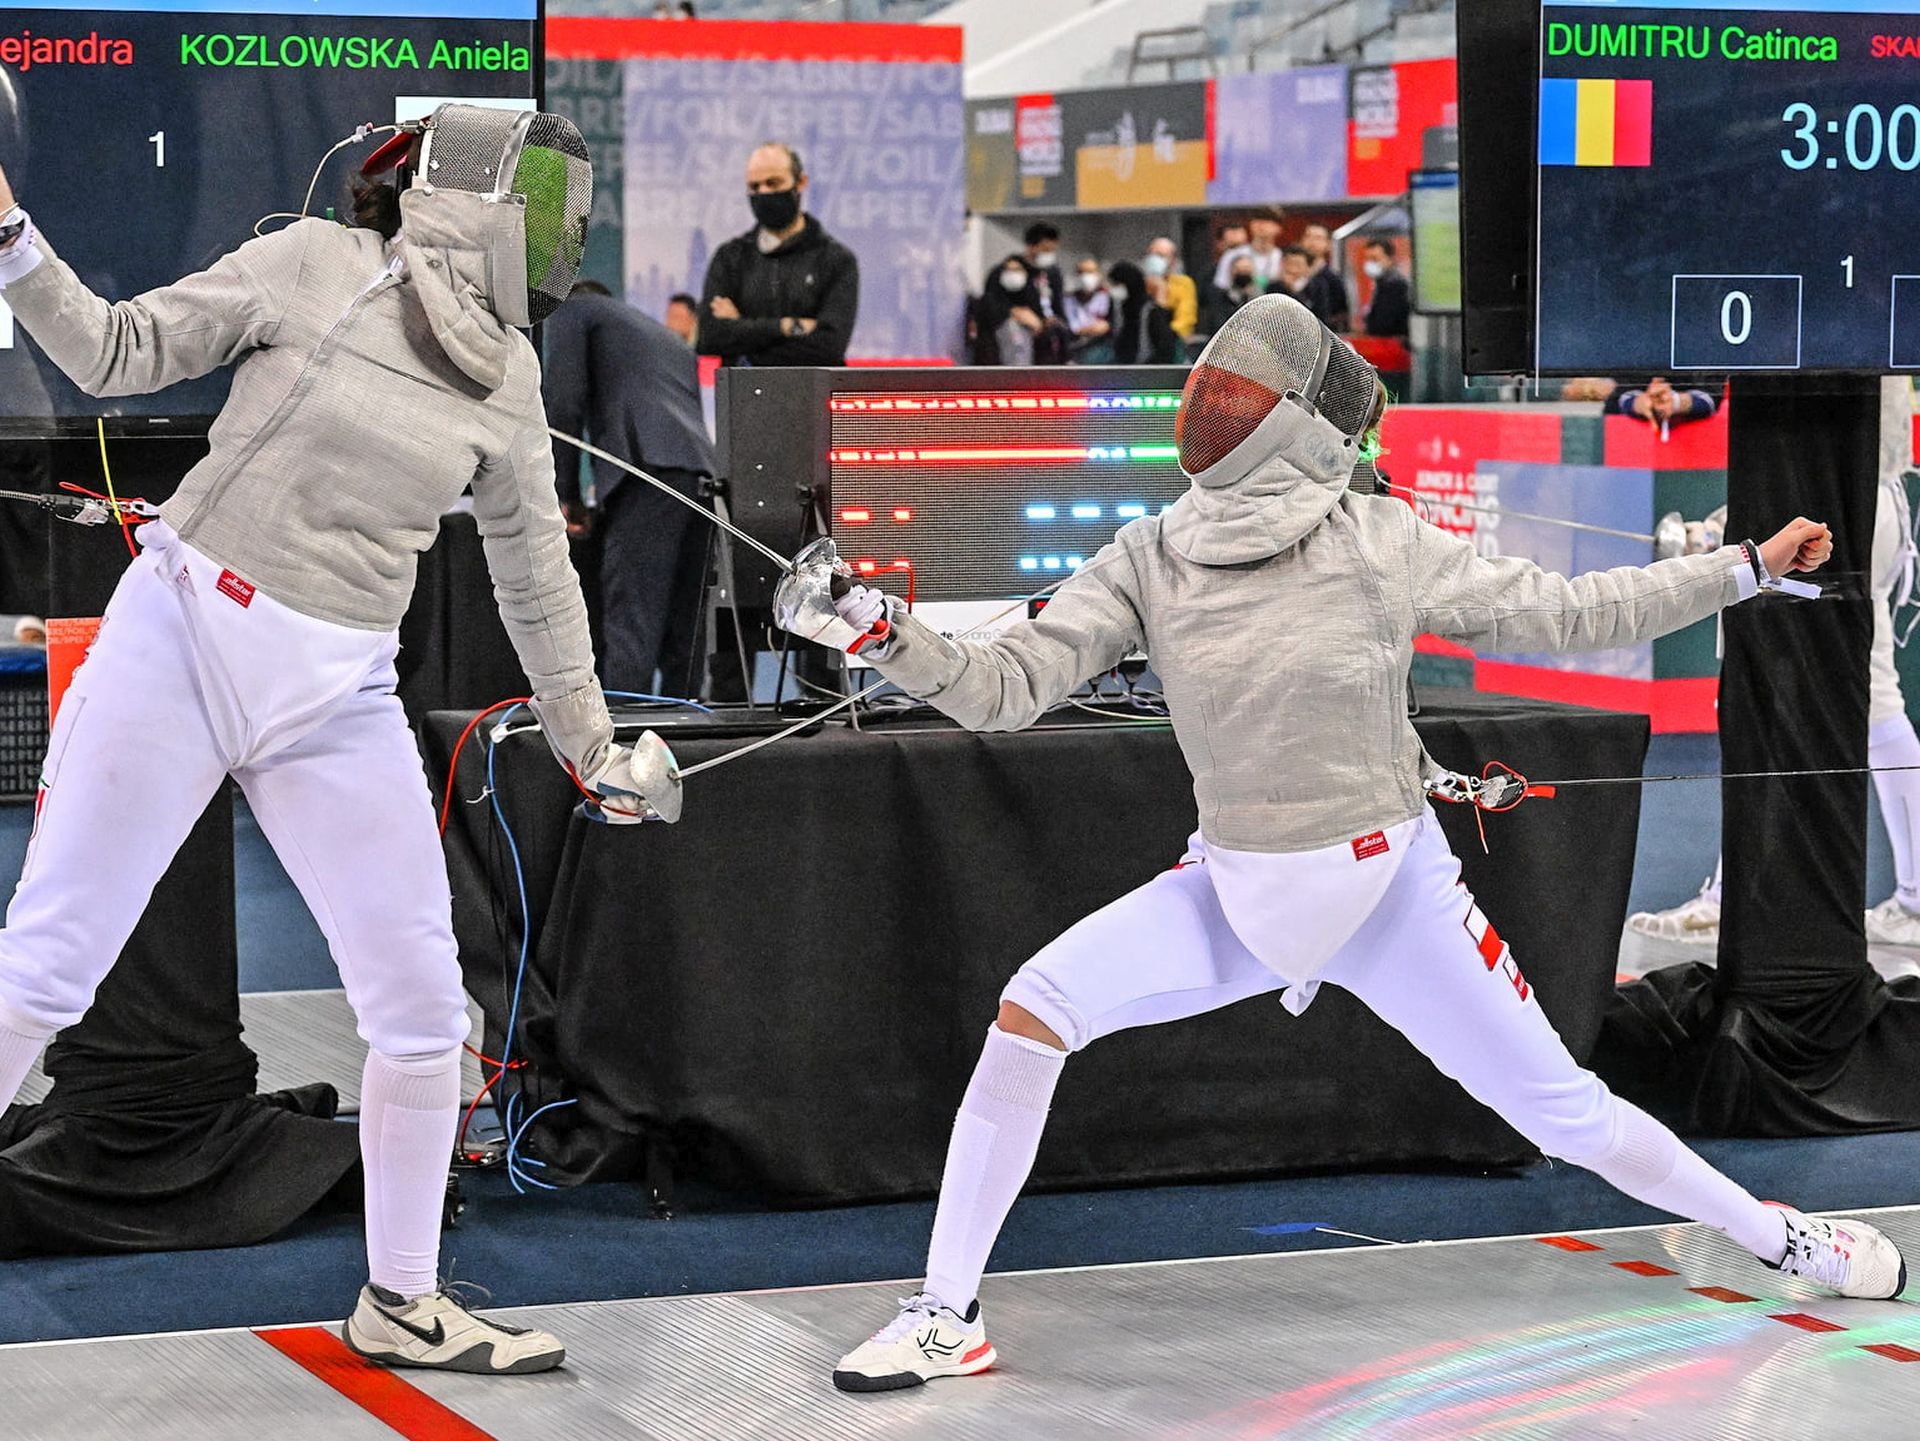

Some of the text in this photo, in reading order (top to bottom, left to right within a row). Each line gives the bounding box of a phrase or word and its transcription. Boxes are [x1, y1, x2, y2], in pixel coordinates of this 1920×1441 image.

[0, 30, 133, 71] ejandra
[181, 34, 529, 71] KOZLOWSKA Aniela
[1548, 22, 1838, 61] DUMITRU Catinca
[1871, 35, 1920, 58] SKA
[148, 131, 166, 168] 1
[1780, 102, 1920, 171] 3:00
[1840, 255, 1854, 288] 1
[1721, 291, 1752, 344] 0
